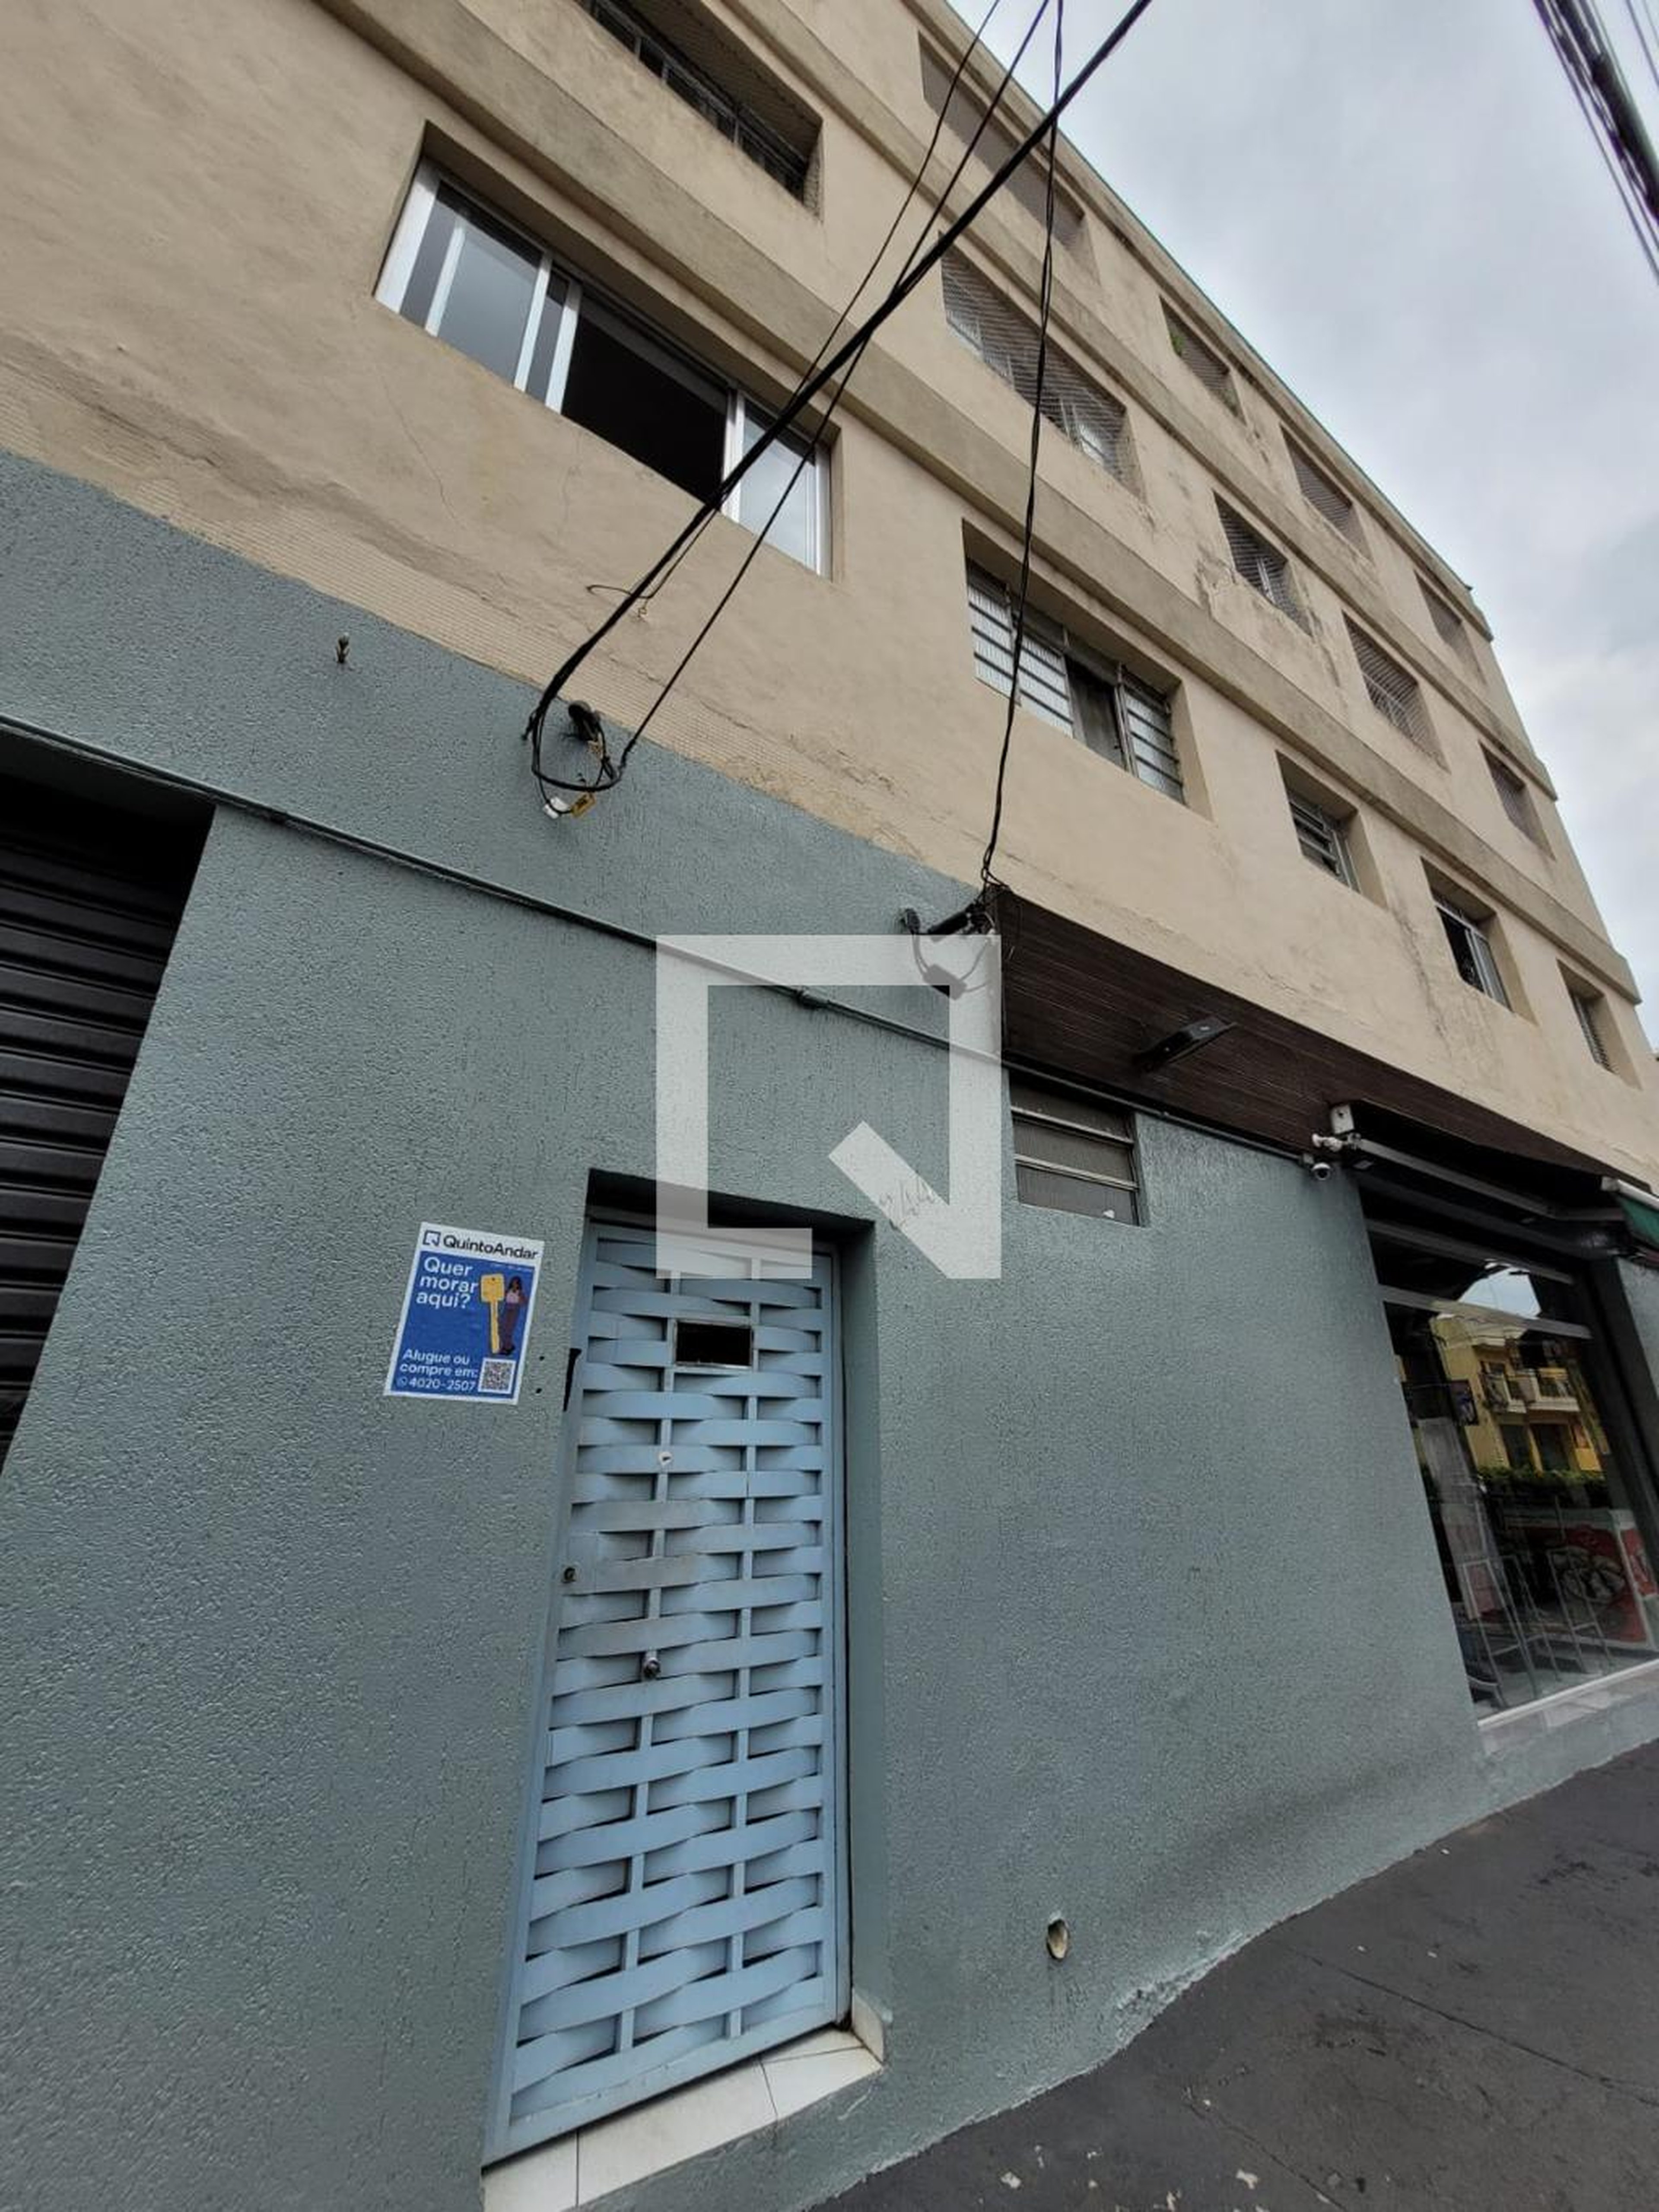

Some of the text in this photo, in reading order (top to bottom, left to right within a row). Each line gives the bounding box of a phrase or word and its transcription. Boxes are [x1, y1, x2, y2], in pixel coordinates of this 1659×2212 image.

[443, 1235, 538, 1260] QuintoAndar
[424, 1257, 474, 1276] Quer
[420, 1276, 479, 1293] morar
[416, 1292, 470, 1309] aqui?
[403, 1349, 470, 1365] Alugue ou
[400, 1363, 479, 1378] compre em:
[409, 1377, 475, 1391] 4020-2507
